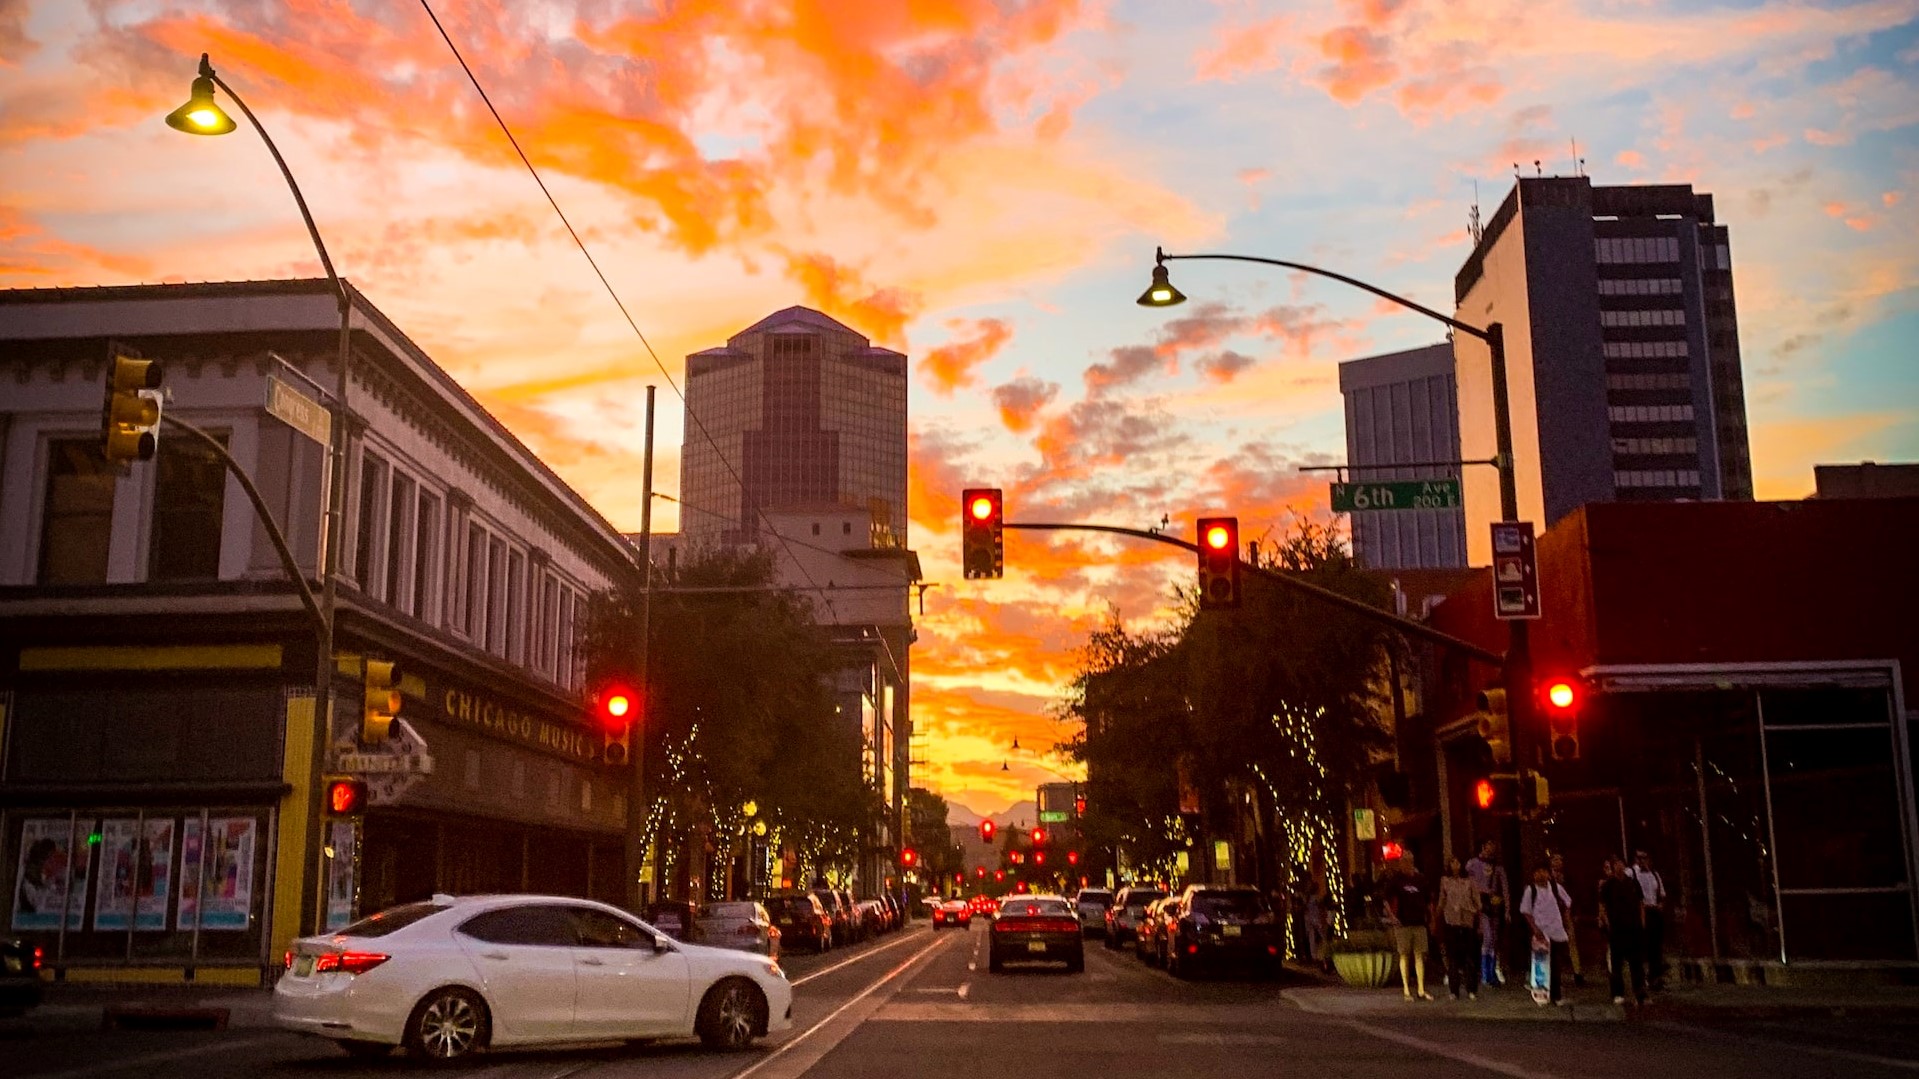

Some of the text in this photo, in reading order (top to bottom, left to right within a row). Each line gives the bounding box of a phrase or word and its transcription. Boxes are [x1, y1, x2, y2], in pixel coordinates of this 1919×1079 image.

[1335, 482, 1450, 509] N 6th Ave
[1414, 496, 1442, 509] 200
[446, 690, 531, 738] CHICAGO
[538, 723, 585, 758] MUSIC
